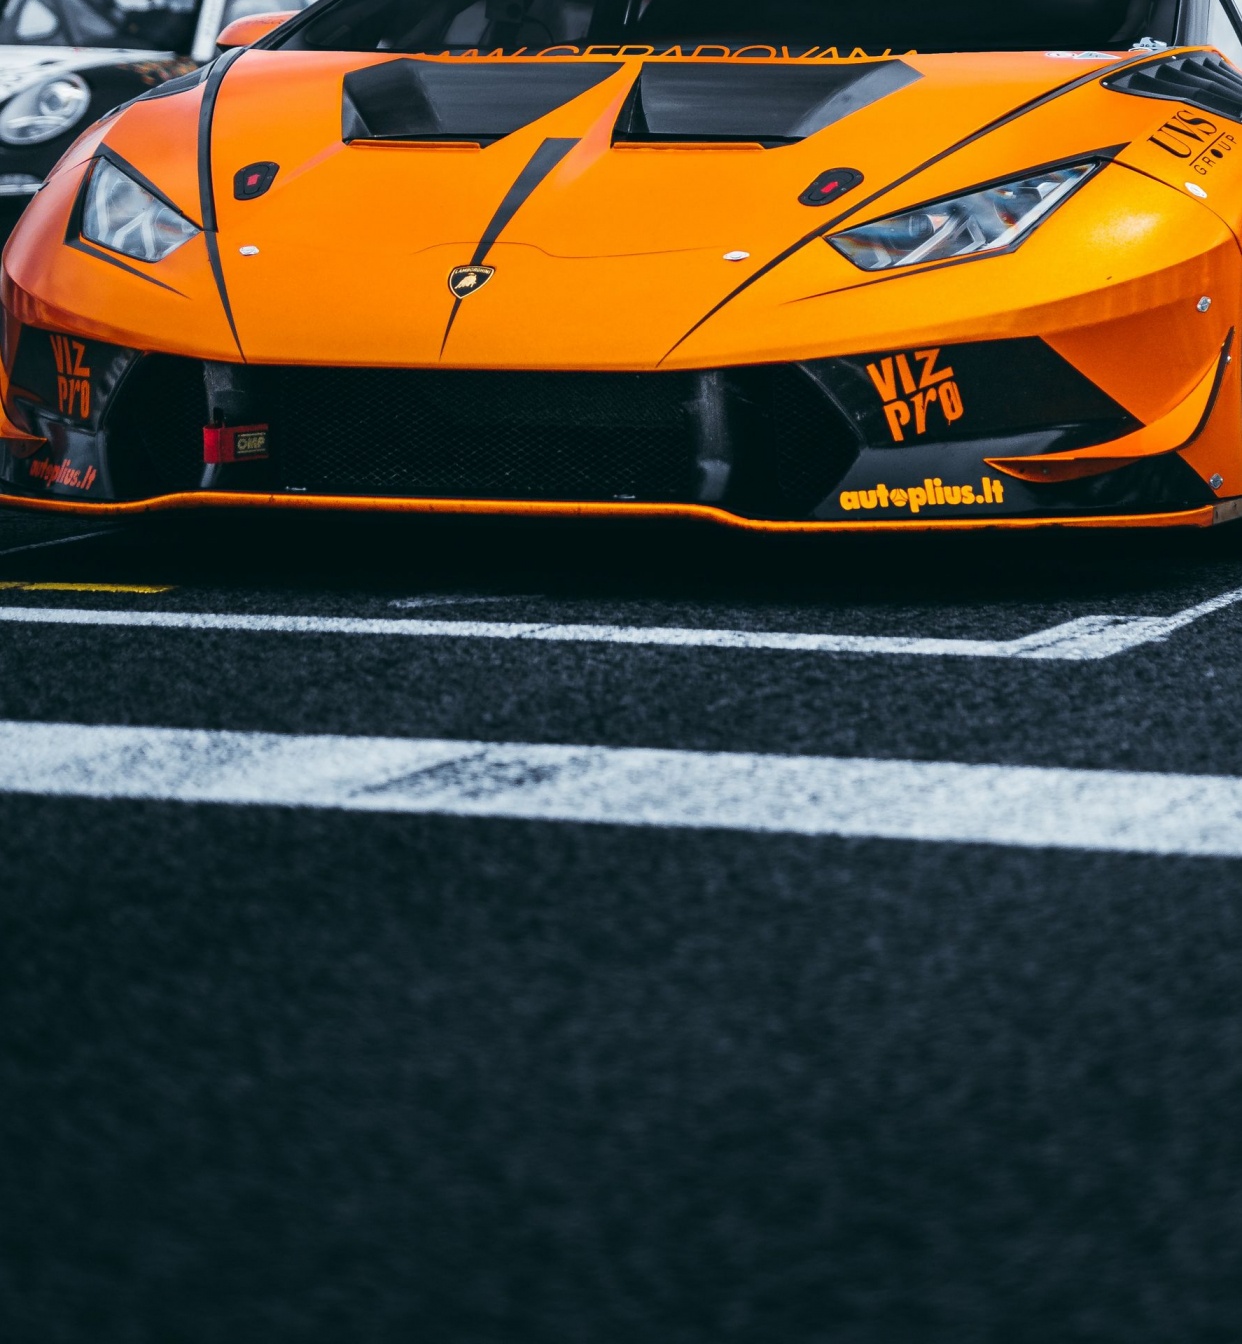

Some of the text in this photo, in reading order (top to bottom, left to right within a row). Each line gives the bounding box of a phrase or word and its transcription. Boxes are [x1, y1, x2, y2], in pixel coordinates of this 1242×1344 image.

[1146, 109, 1217, 158] UVS
[50, 335, 90, 377] VIZ
[866, 348, 954, 403] VIZ
[237, 437, 265, 449] OMP
[29, 457, 97, 490] autoplius.lt
[840, 476, 1003, 513] autoplius.lt
